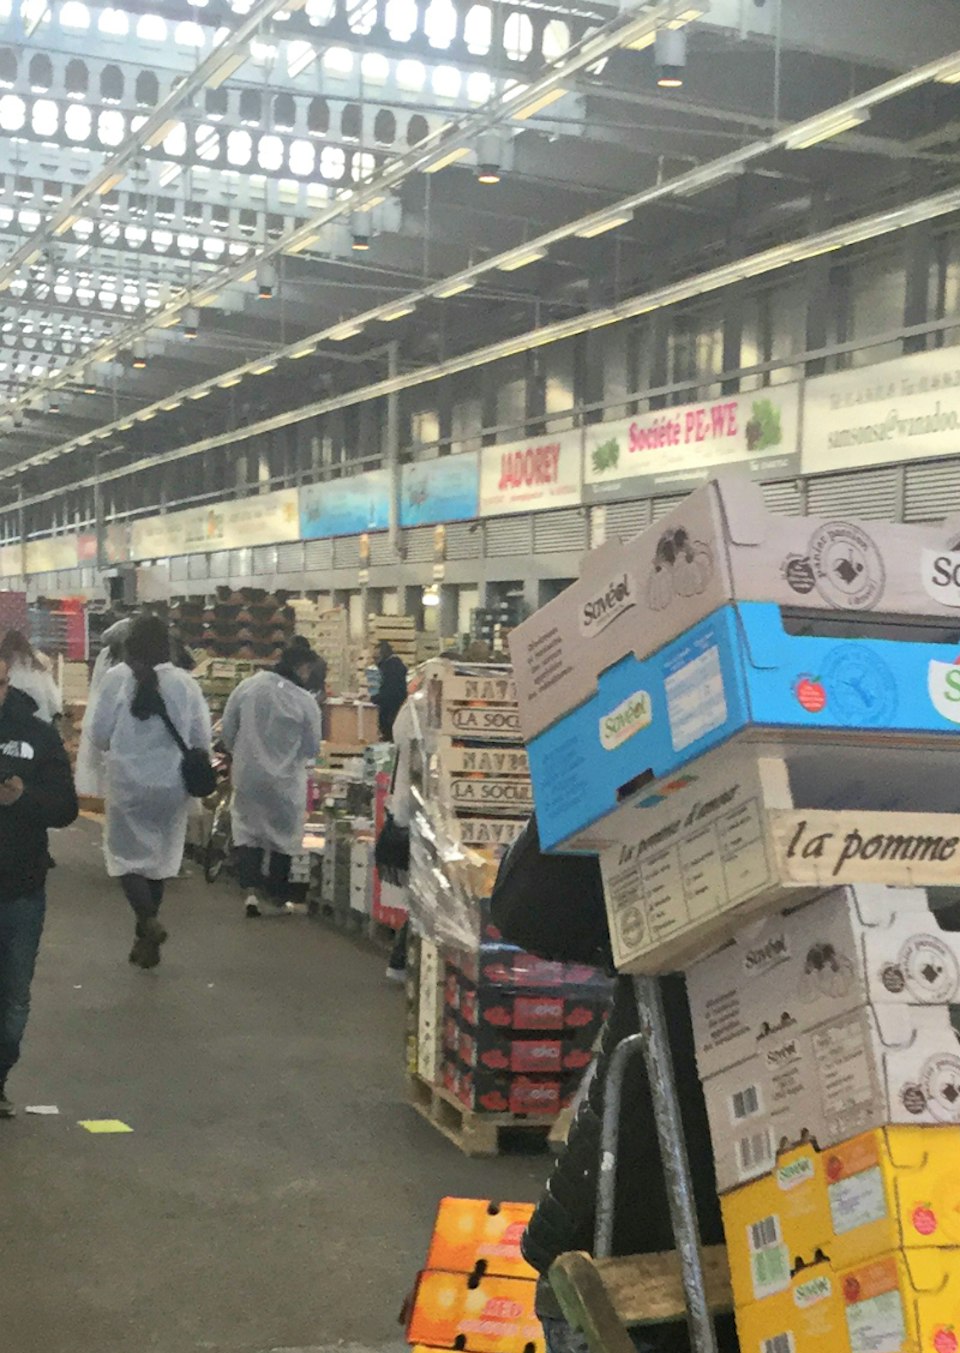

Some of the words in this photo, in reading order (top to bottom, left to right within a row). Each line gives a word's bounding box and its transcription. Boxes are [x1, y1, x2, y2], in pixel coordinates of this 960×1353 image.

[629, 413, 681, 453] Société
[684, 402, 738, 444] PE-WE
[584, 574, 630, 626] Savéol
[787, 820, 833, 859] la
[832, 828, 960, 876] pomme
